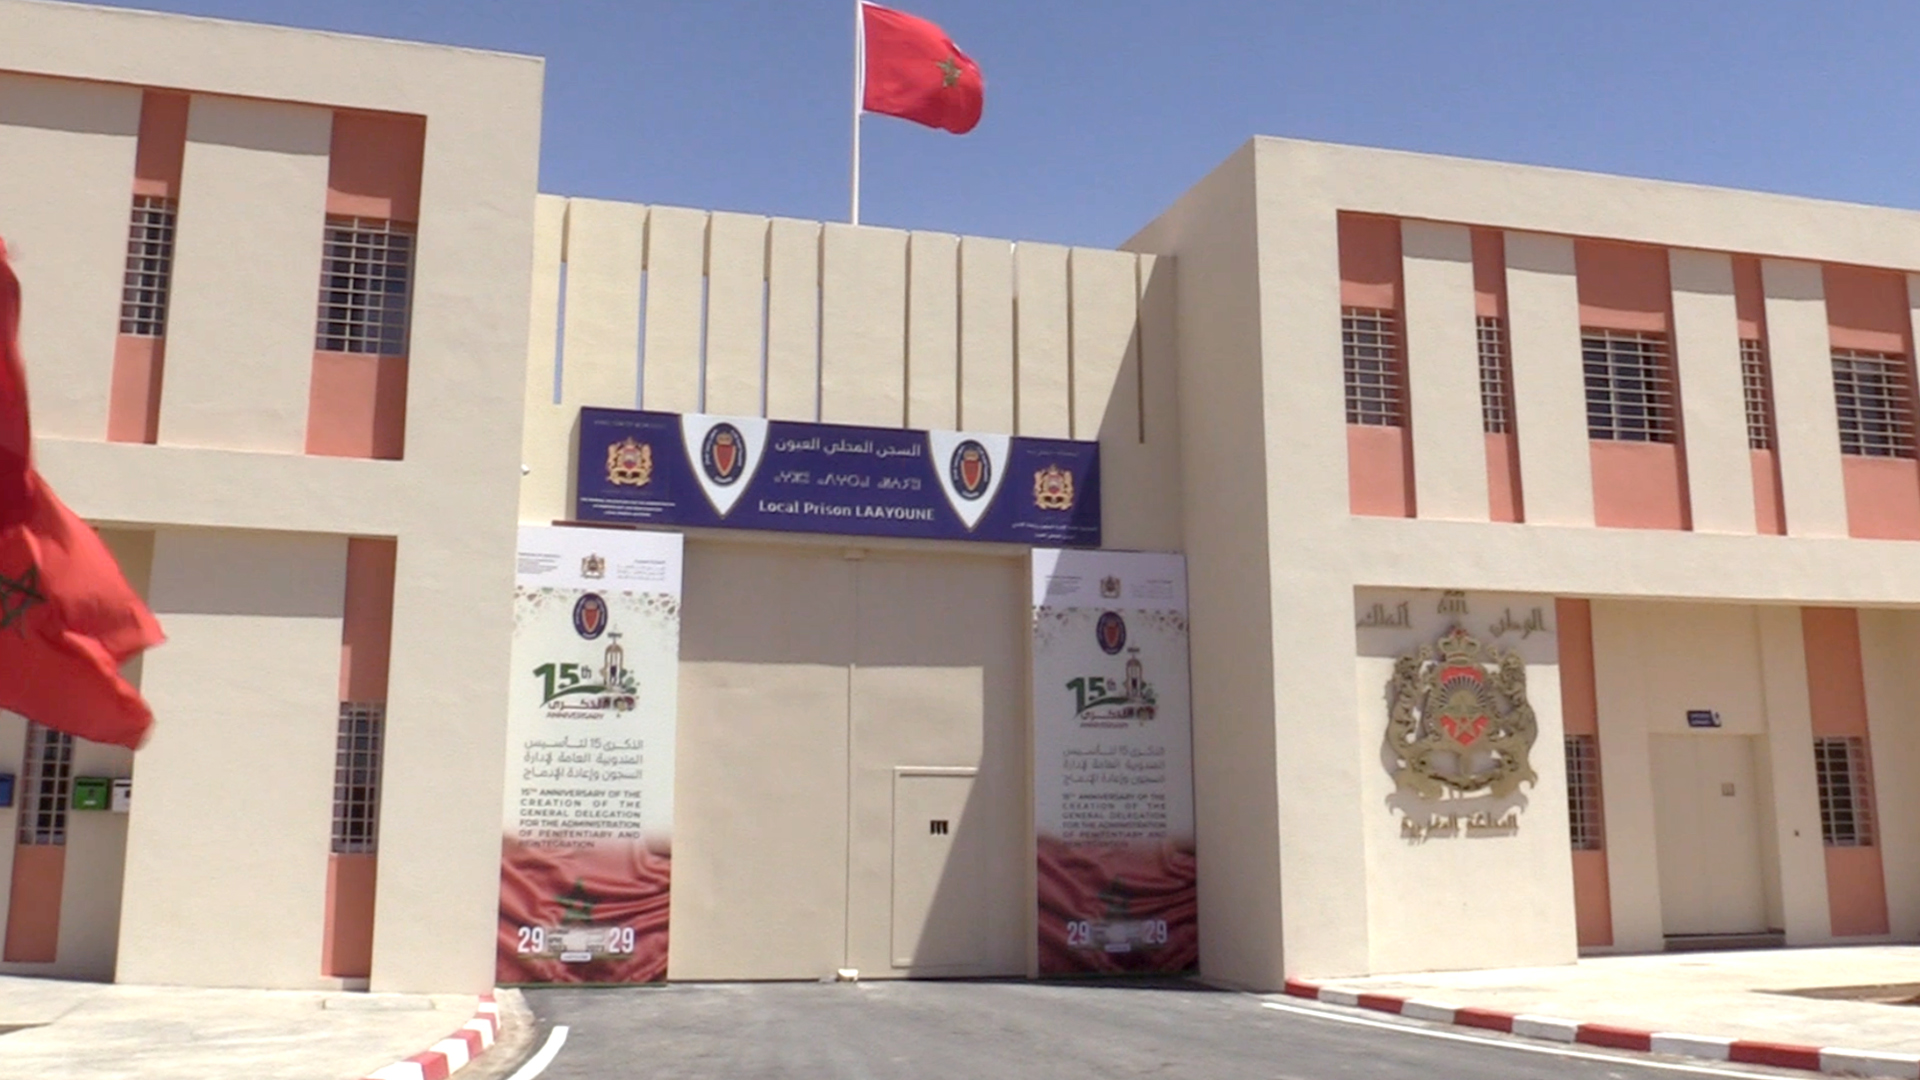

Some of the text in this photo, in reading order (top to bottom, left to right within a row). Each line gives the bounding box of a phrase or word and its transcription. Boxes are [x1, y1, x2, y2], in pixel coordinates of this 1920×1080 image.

[774, 437, 921, 458] السجن المحلي العيون
[758, 500, 935, 521] Local Prison LAAYOUNE
[557, 752, 591, 764] العامة
[539, 788, 606, 798] ANNIVERSARY
[608, 789, 621, 798] OF
[624, 790, 642, 798] THE
[520, 799, 641, 809] CREATION OF THE
[520, 808, 641, 819] GENERAL DELEGATION
[519, 819, 641, 829] FOR THE ADMINISTRATION
[519, 829, 640, 839] OF PENITENTIARY AND
[518, 927, 545, 953] 29
[609, 927, 635, 953] 29
[1067, 921, 1091, 945] 29
[1145, 920, 1167, 944] 29
